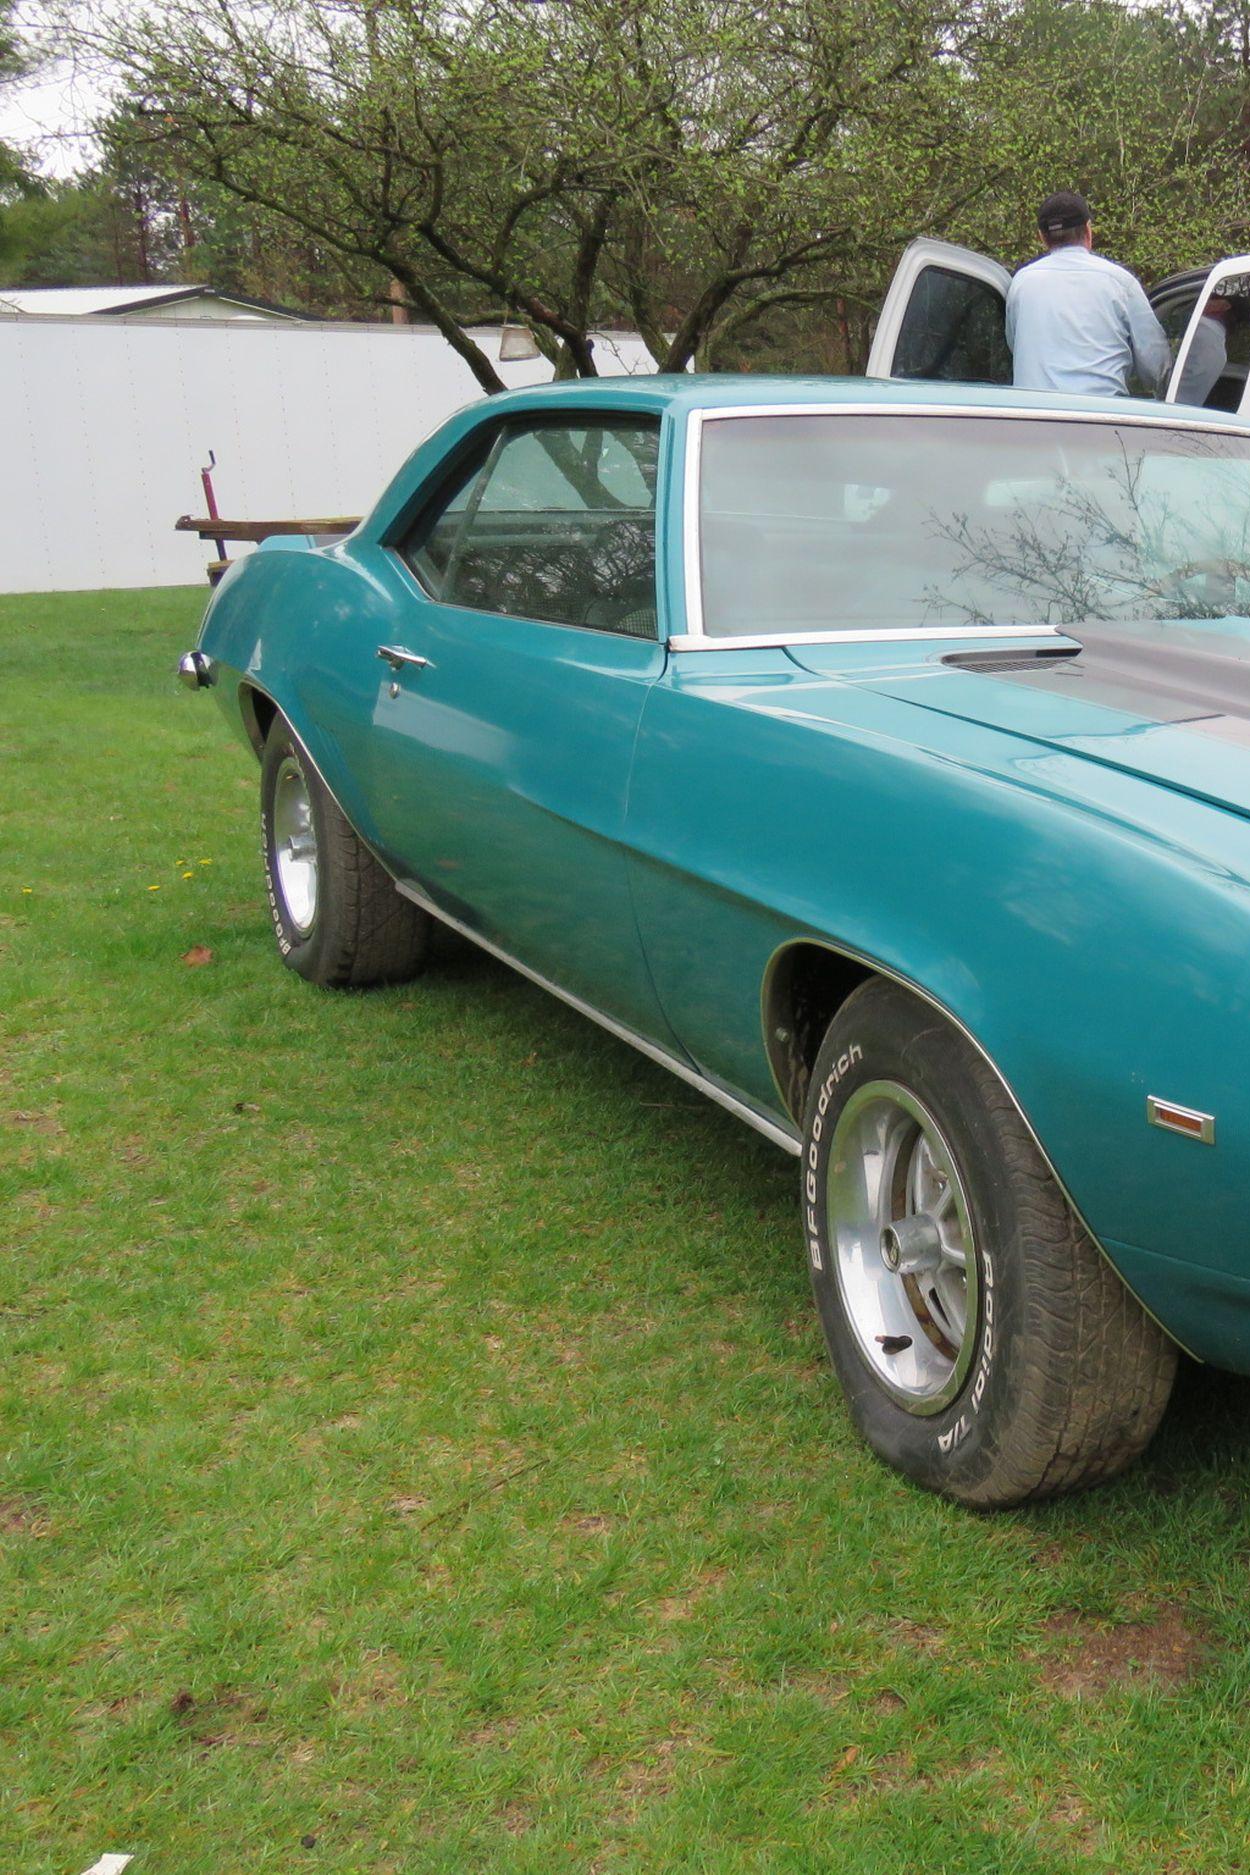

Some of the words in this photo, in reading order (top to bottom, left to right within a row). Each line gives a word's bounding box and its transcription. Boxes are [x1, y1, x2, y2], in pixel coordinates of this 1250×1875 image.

[806, 1043, 864, 1271] BFGoodrich
[971, 1250, 994, 1415] Radial
[937, 1415, 971, 1453] T/A
